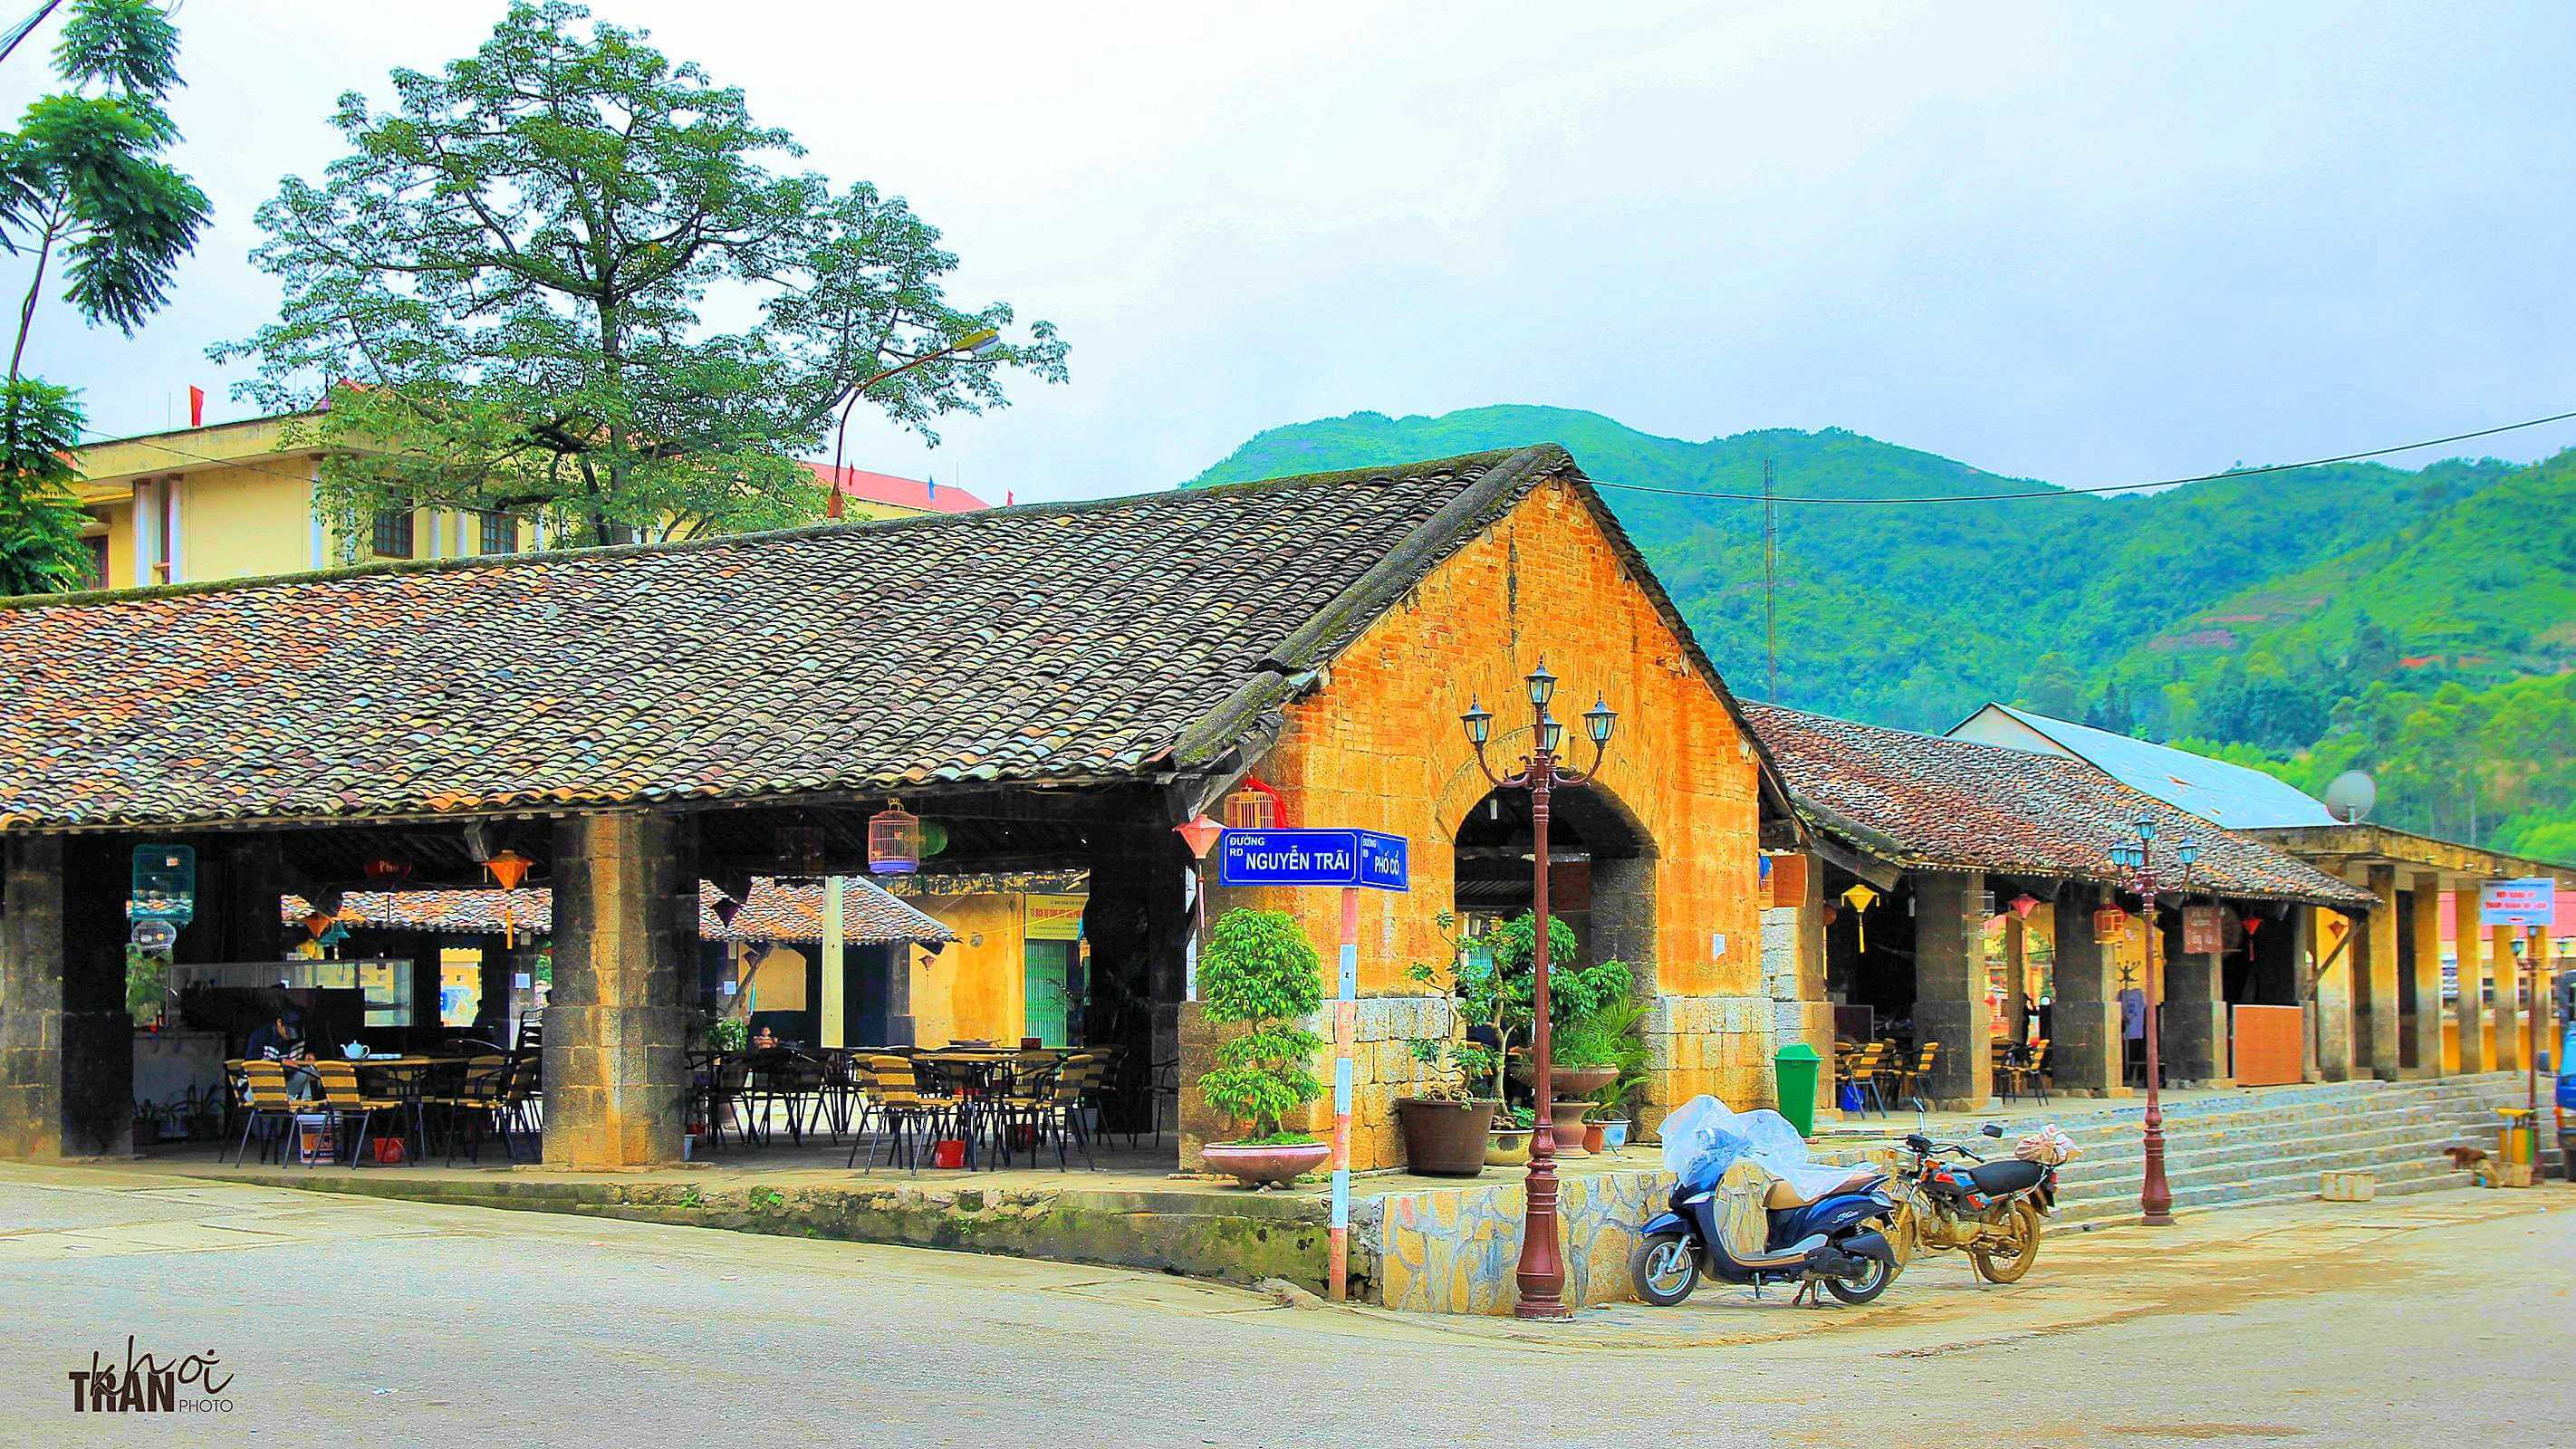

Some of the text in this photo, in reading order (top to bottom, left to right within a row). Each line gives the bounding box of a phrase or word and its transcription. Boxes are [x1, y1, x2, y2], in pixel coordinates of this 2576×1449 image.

[1229, 835, 1265, 846] ĐƯỜNG
[1230, 849, 1244, 857] RD
[1245, 845, 1350, 870] NGUYỄN TRÃI
[1374, 849, 1400, 875] PHỐ CỔ
